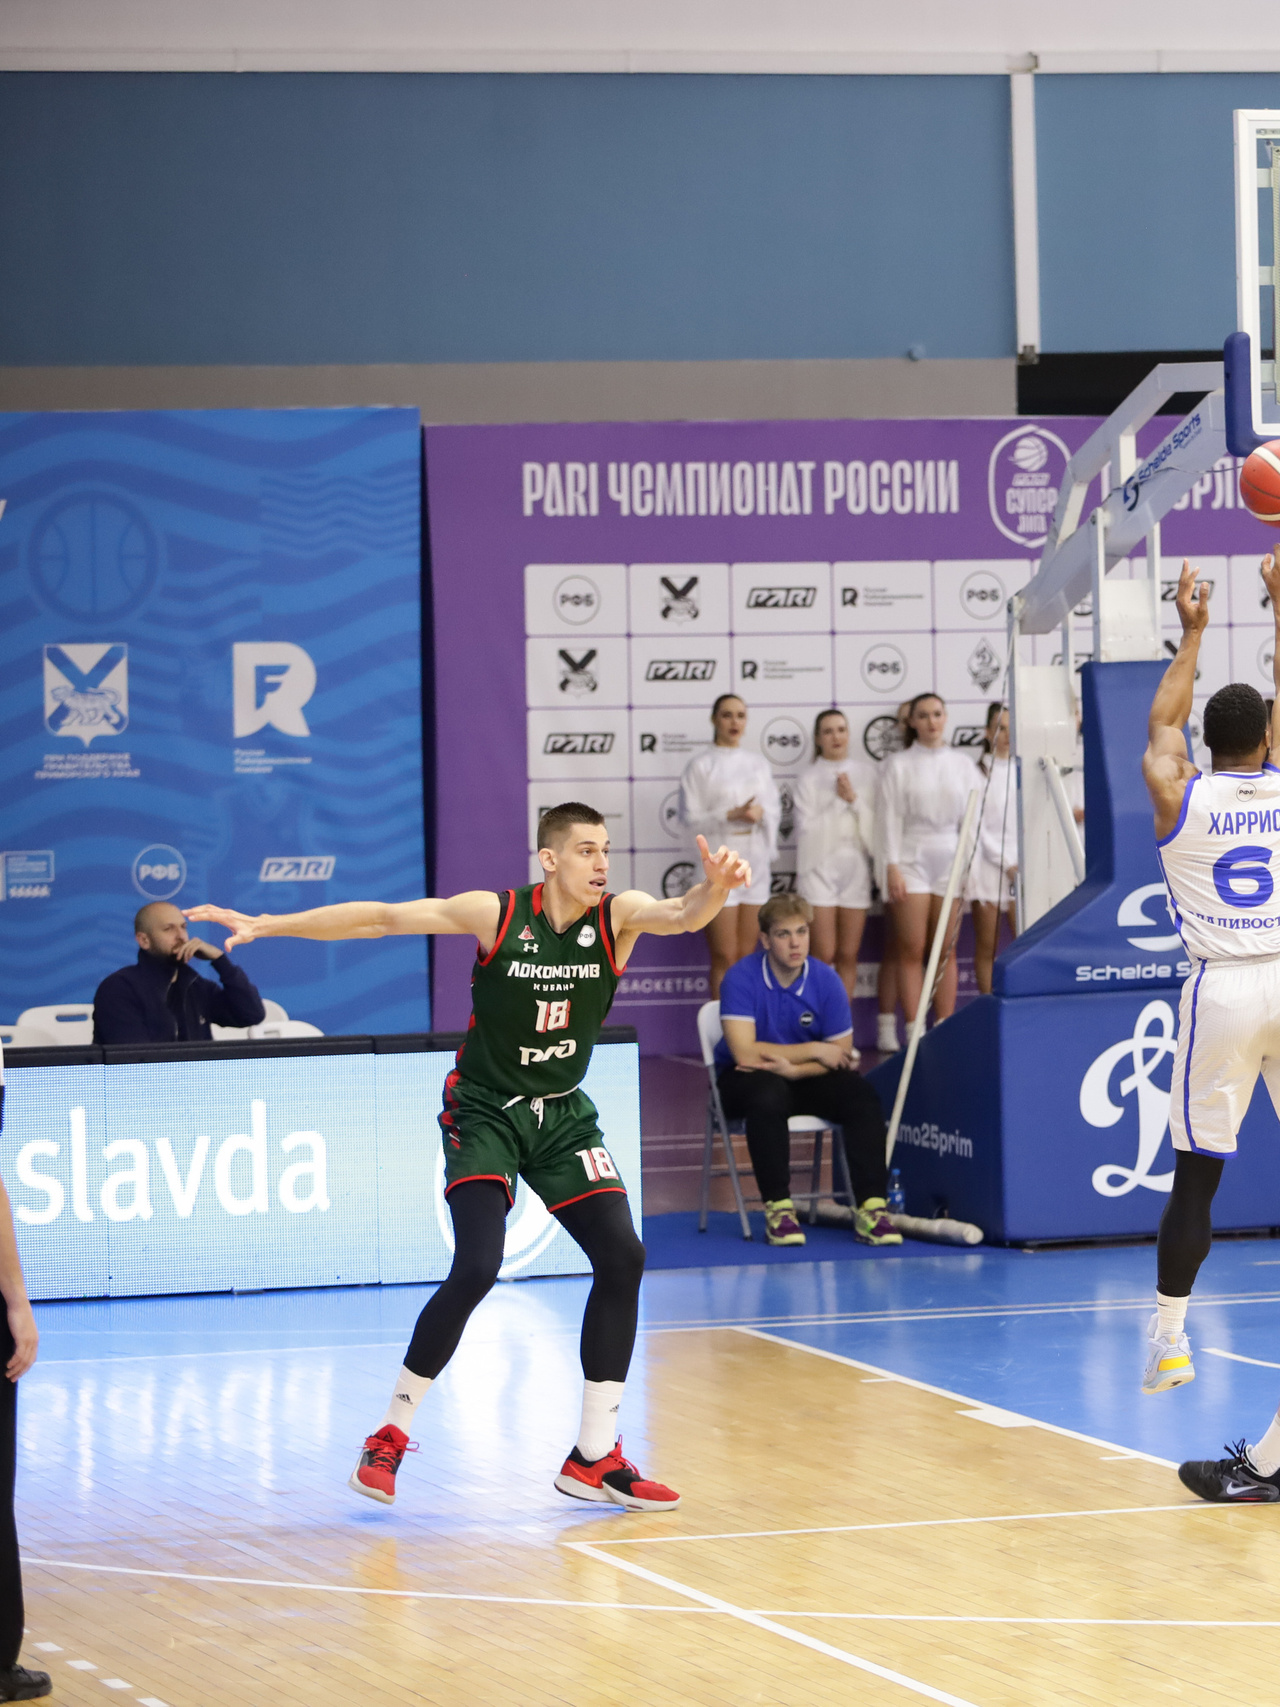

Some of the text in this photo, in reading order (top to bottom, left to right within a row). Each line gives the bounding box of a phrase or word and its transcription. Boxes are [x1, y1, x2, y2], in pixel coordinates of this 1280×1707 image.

[1172, 413, 1202, 450] Sports
[523, 459, 960, 517] PARI ЧЕМПИОНАТ РОССИИ
[139, 863, 180, 881] РФБ
[261, 856, 335, 882] PARI
[1212, 845, 1274, 909] 6
[507, 961, 601, 979] ЛОКОМОТИВ
[533, 982, 575, 992] КУБАНЬ
[1075, 962, 1172, 982] Schelde
[535, 999, 571, 1033] 18
[15, 1099, 331, 1225] slavda
[574, 1146, 618, 1182] 18
